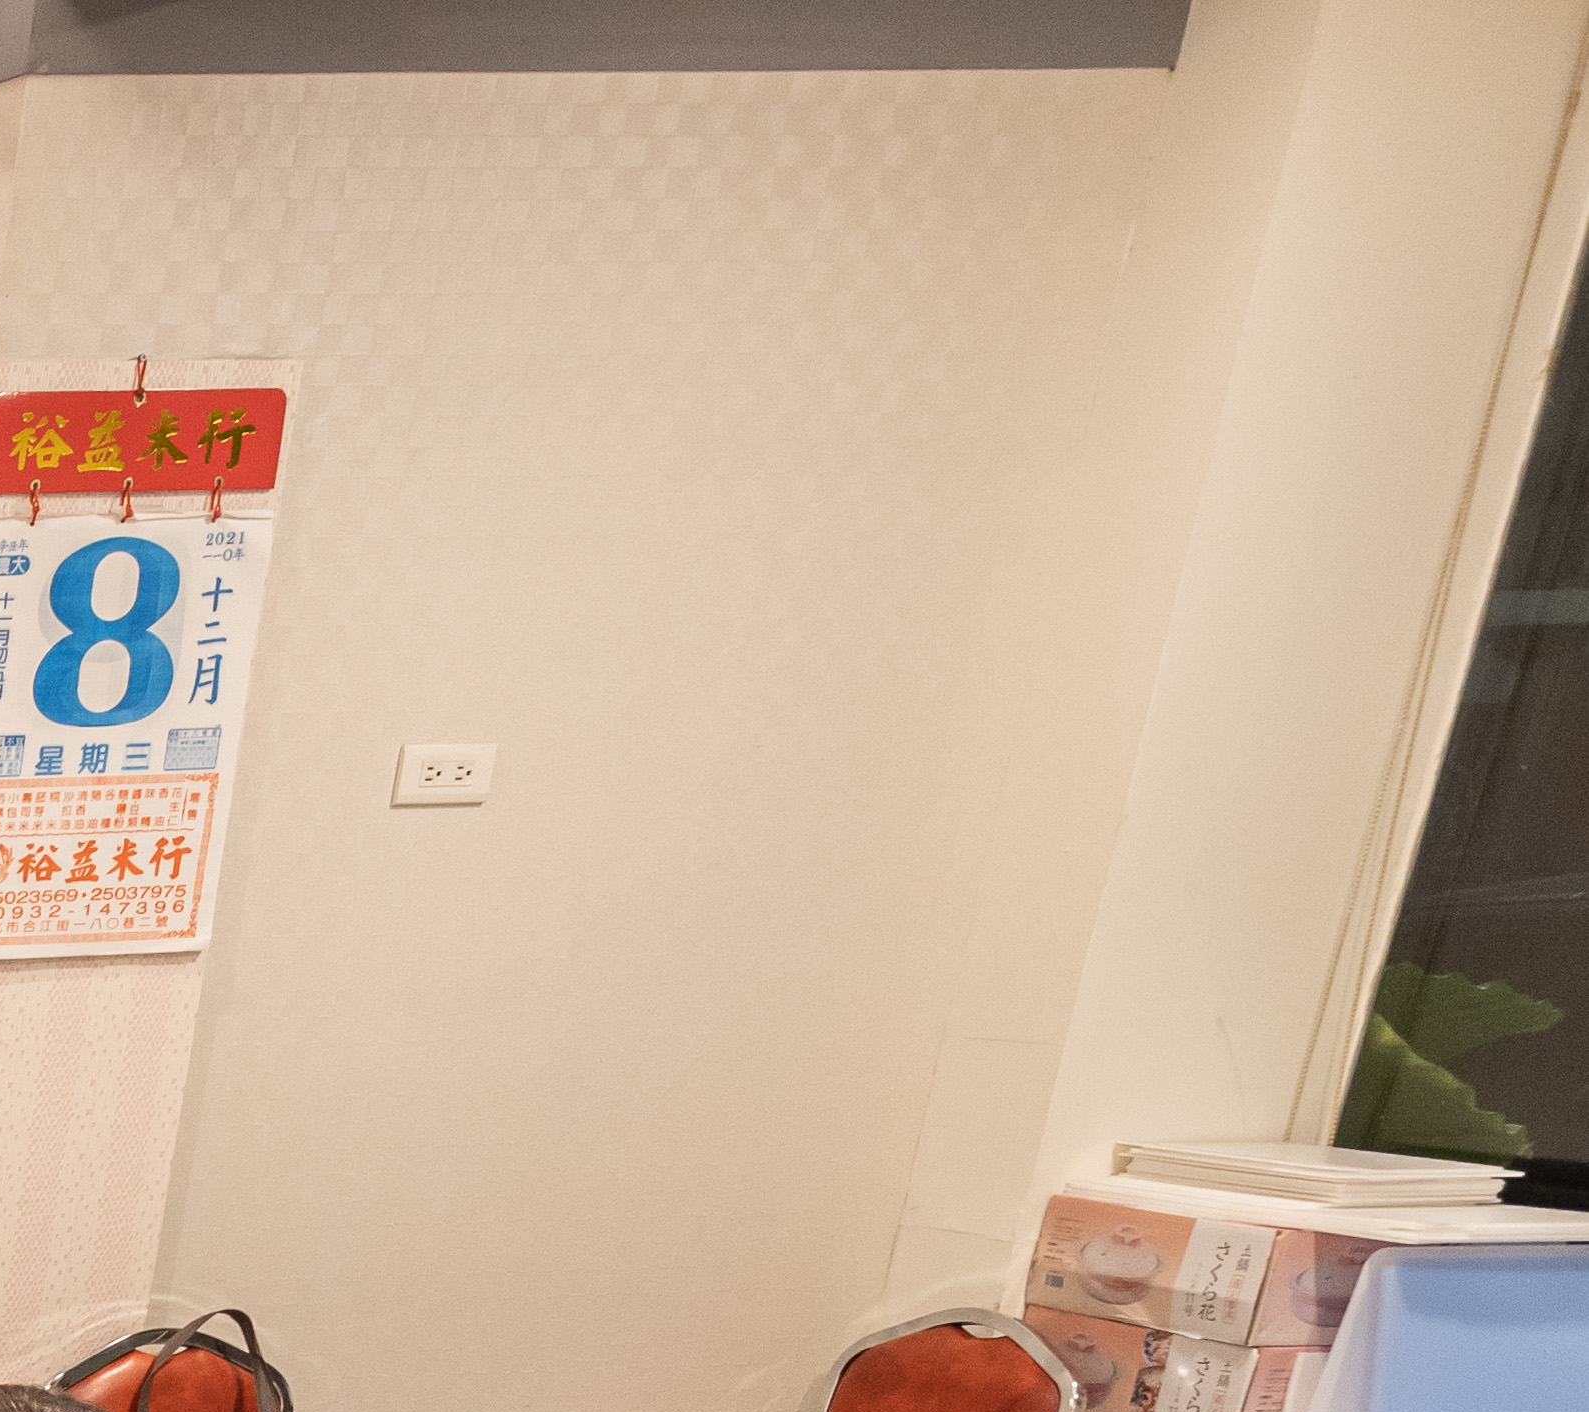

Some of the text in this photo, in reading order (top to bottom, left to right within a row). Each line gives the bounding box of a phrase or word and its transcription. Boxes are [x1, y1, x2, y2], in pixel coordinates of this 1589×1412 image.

[9, 407, 257, 472] 裕益米行
[205, 531, 246, 548] 2021
[31, 535, 181, 728] 8
[187, 576, 234, 706] 十二月
[34, 742, 152, 776] 星期三
[16, 835, 193, 885] 裕益米行
[1197, 1240, 1231, 1322] さくら花
